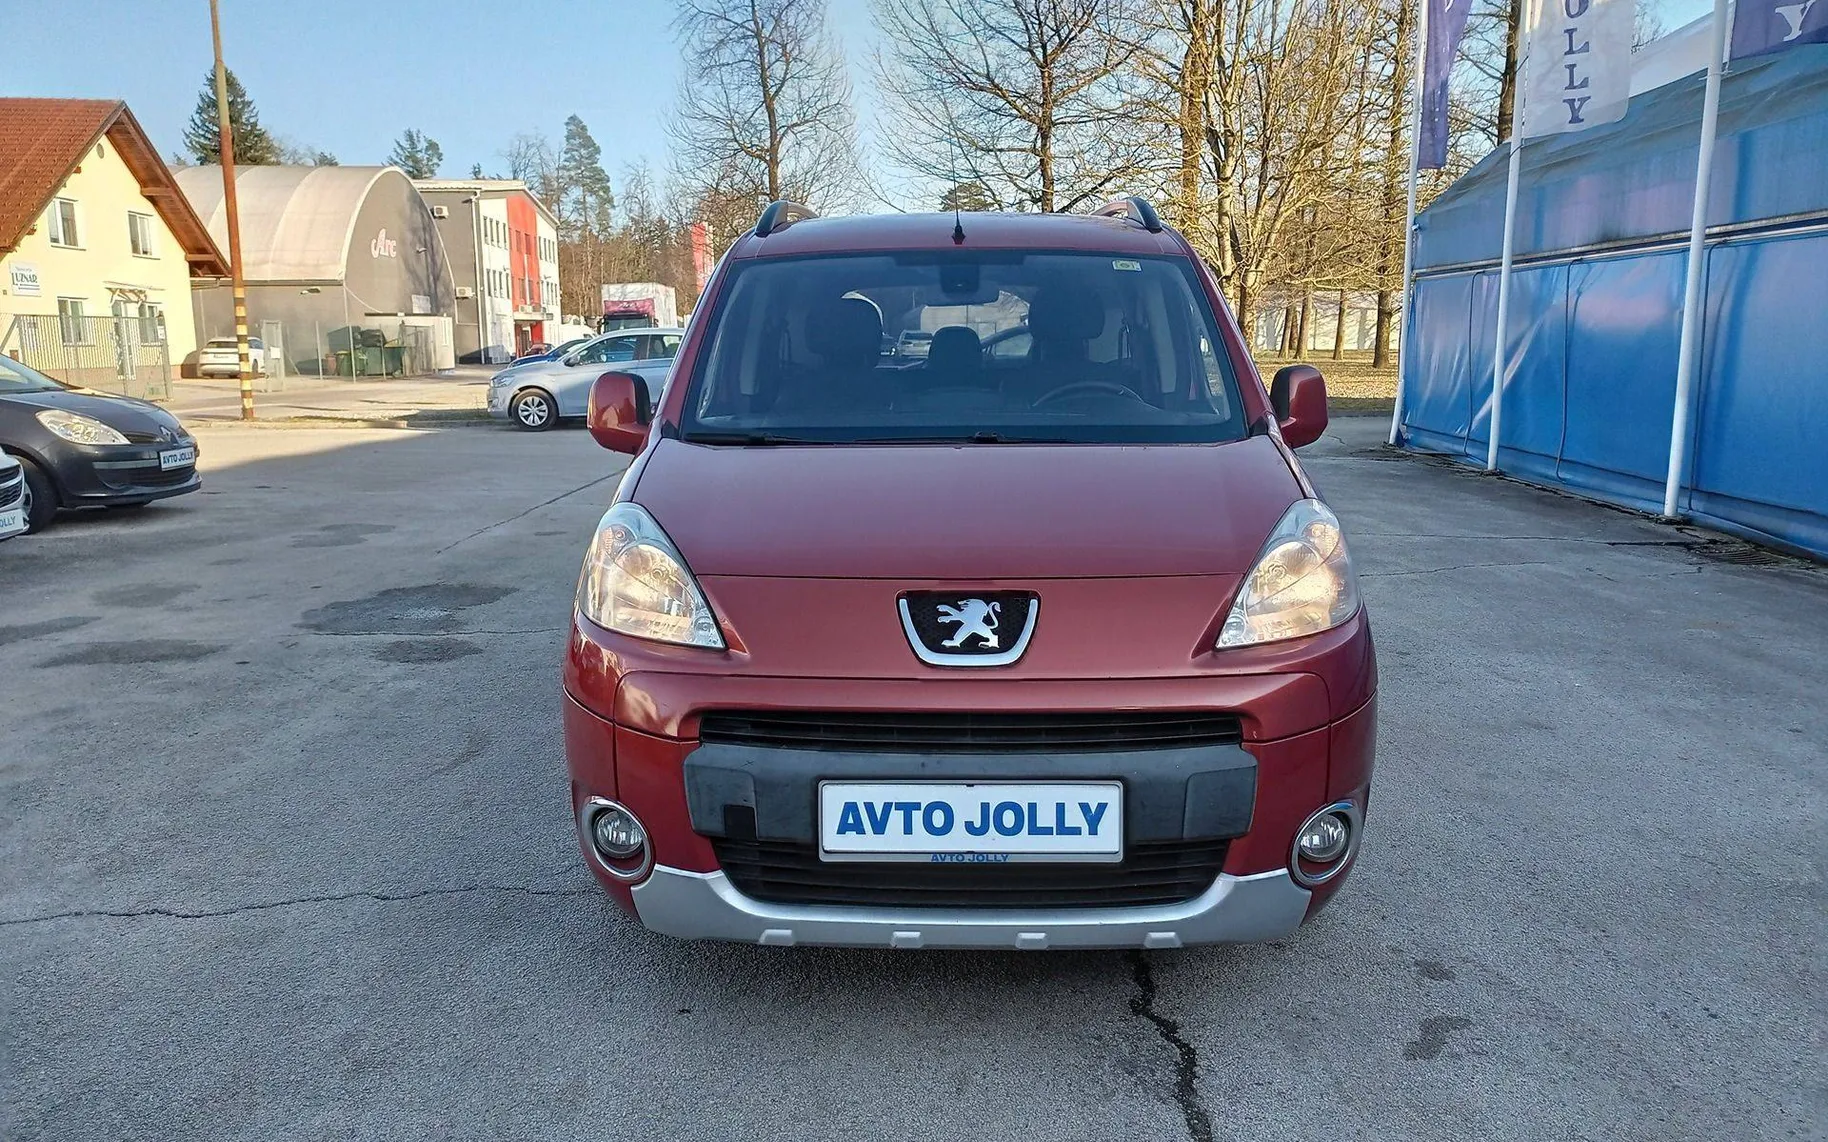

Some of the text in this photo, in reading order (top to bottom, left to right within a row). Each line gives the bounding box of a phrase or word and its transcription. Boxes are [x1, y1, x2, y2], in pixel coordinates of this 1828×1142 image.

[163, 451, 193, 465] AVTO JOLLY
[836, 801, 1108, 836] AVTO JOLLY
[931, 854, 1009, 862] AVTO JOLLY
